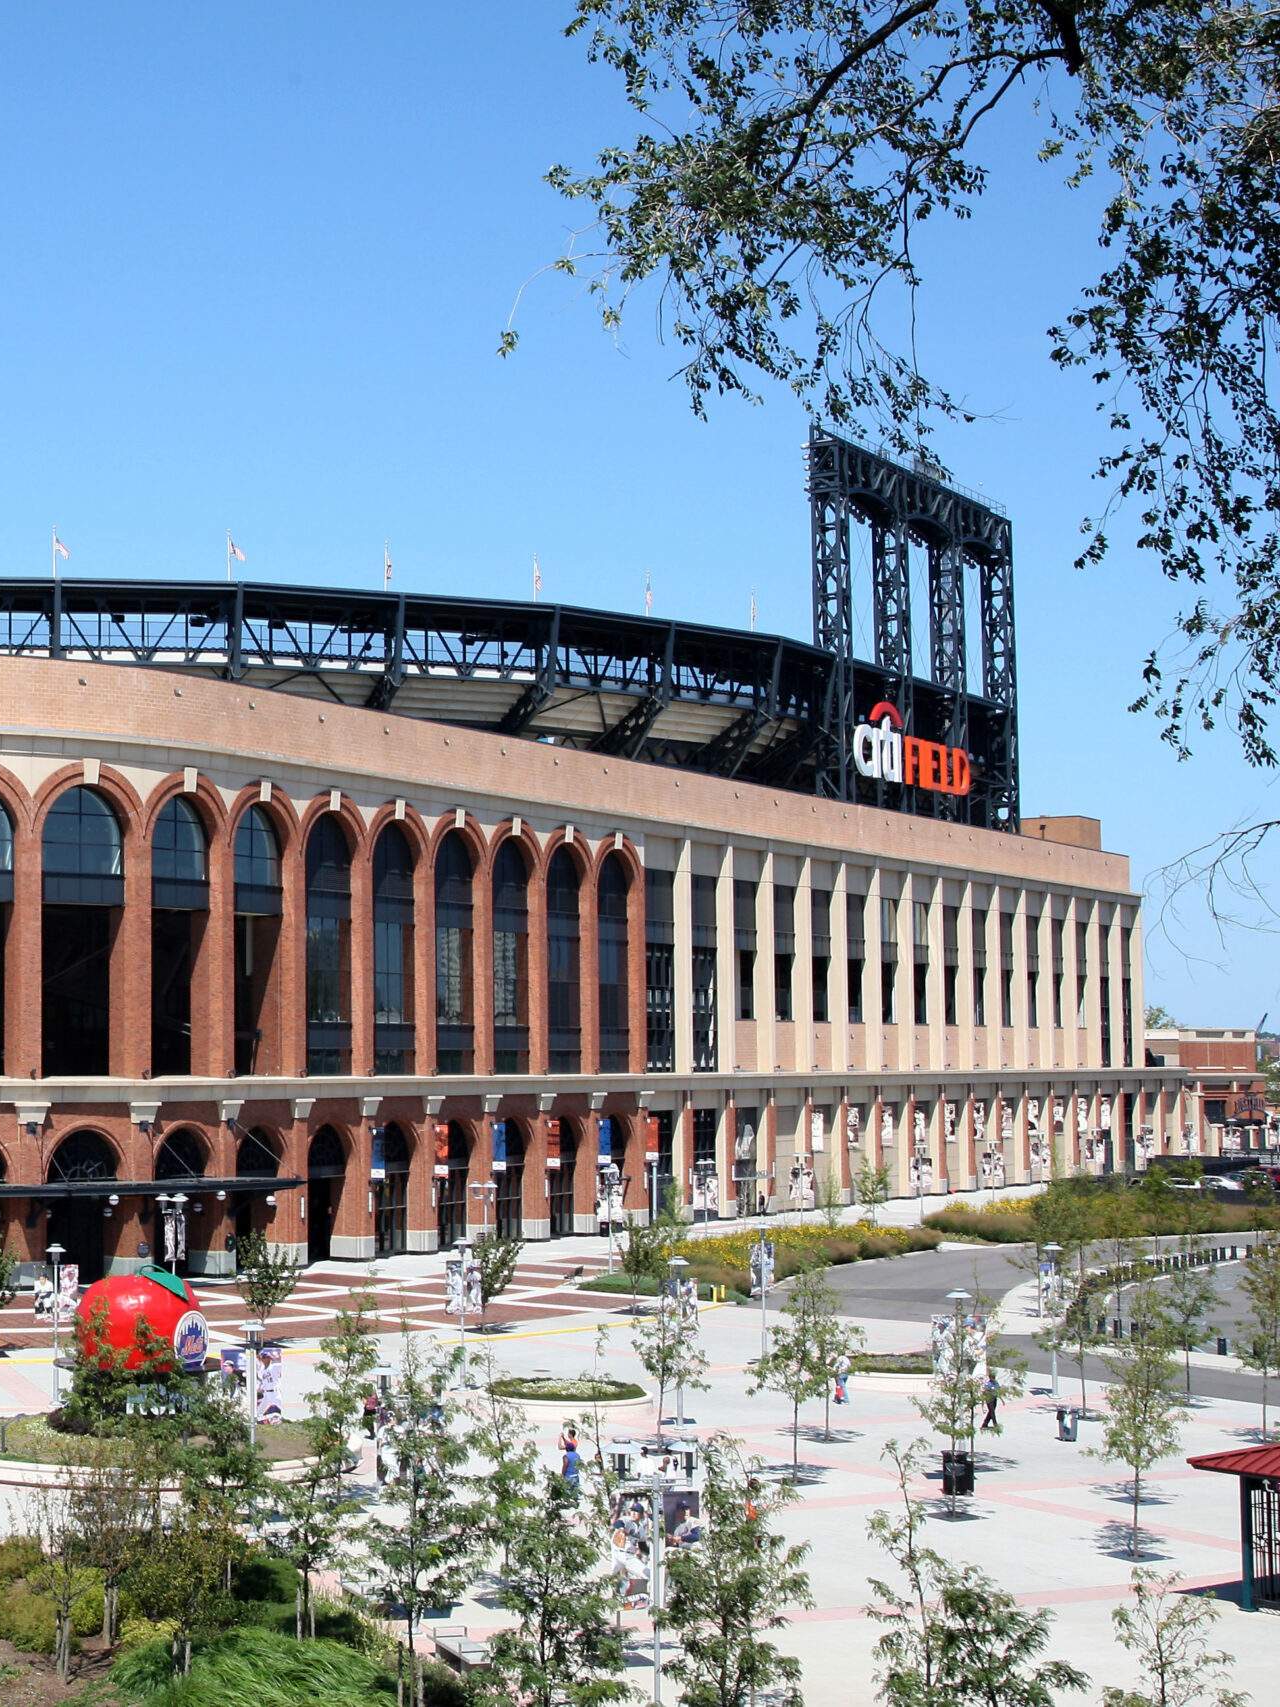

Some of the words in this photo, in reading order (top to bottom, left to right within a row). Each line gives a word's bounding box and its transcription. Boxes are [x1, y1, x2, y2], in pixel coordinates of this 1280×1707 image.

[853, 712, 902, 783] citi
[904, 735, 972, 796] FIELD
[181, 1335, 204, 1356] Mets
